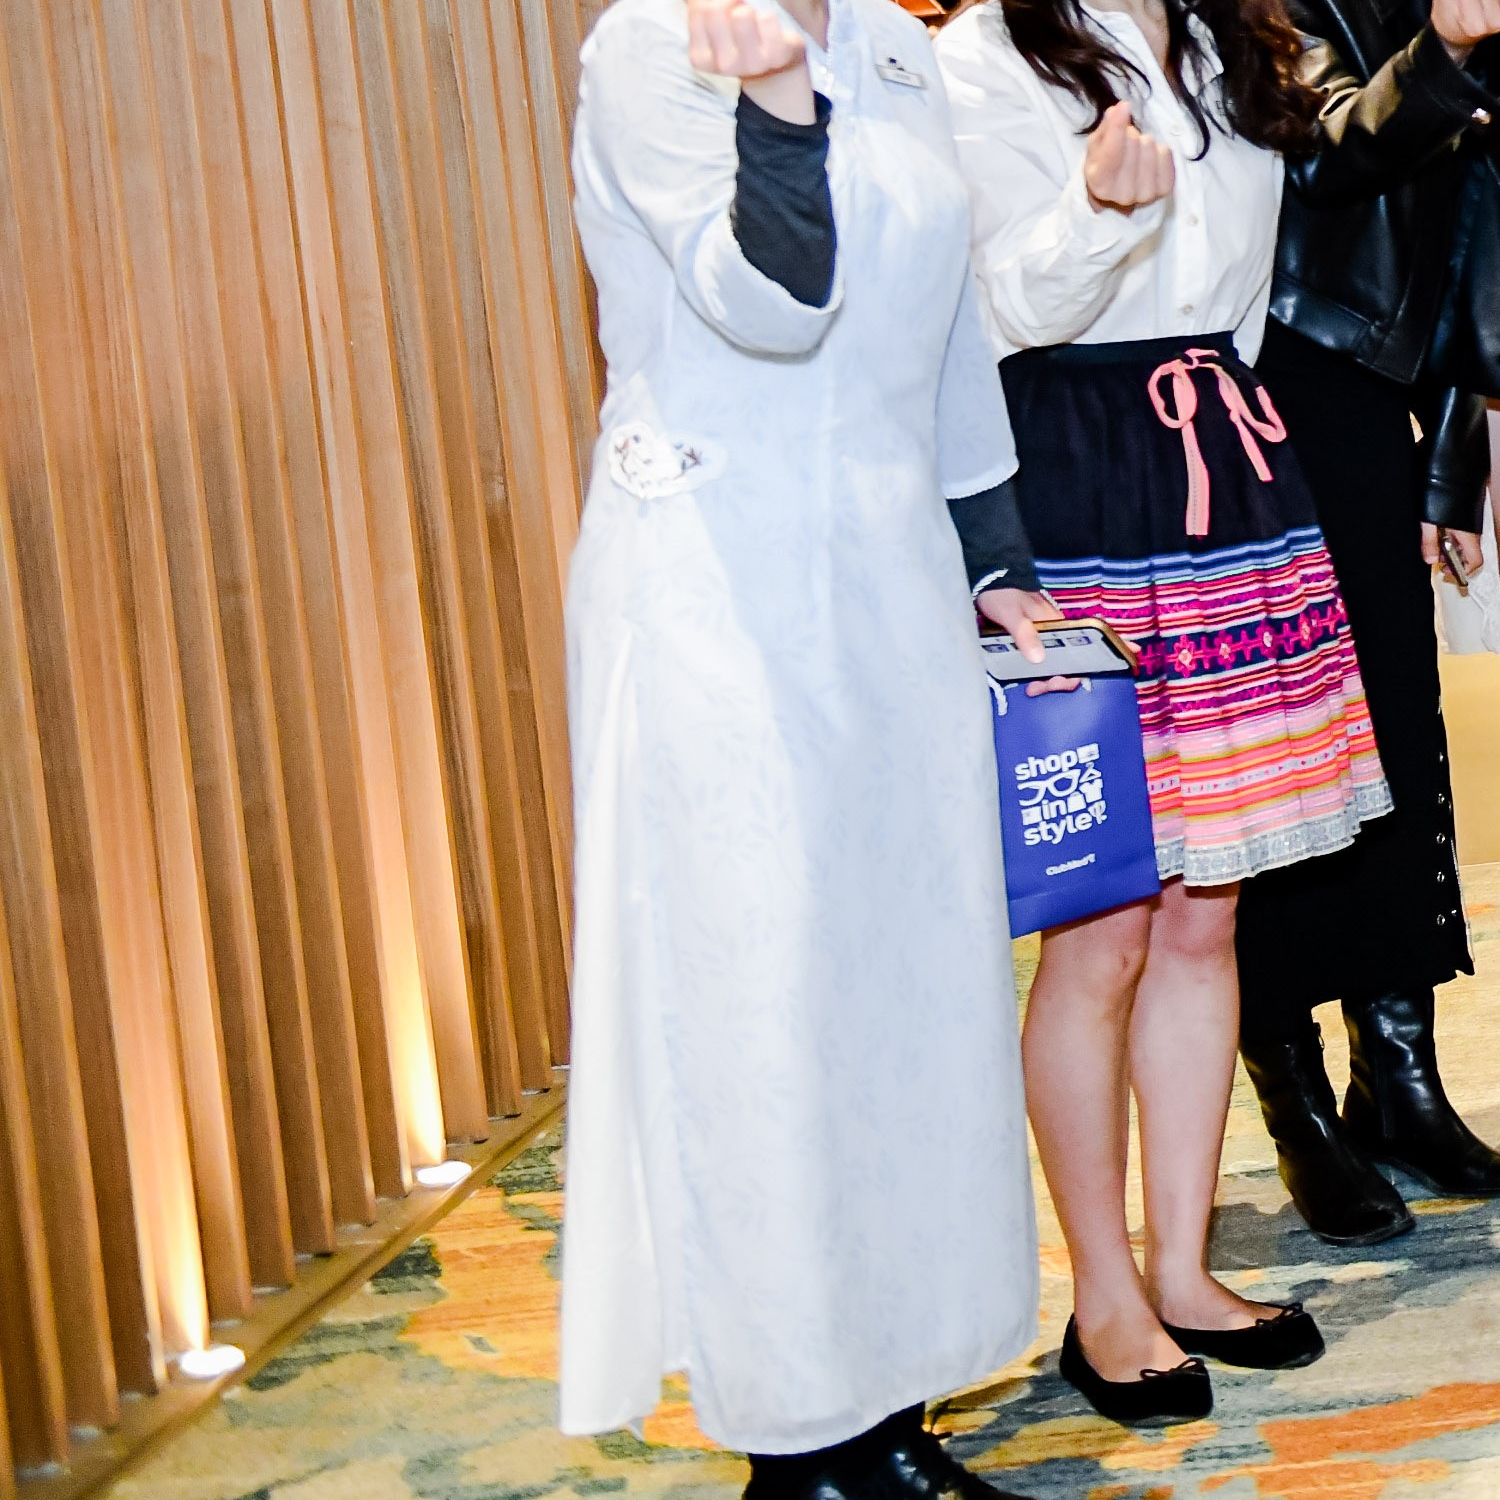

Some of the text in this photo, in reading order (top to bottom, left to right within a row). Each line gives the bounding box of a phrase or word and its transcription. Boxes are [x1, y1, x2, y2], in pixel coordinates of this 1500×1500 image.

[1015, 750, 1078, 780] shop
[1042, 799, 1067, 820] in
[1023, 813, 1093, 846] style
